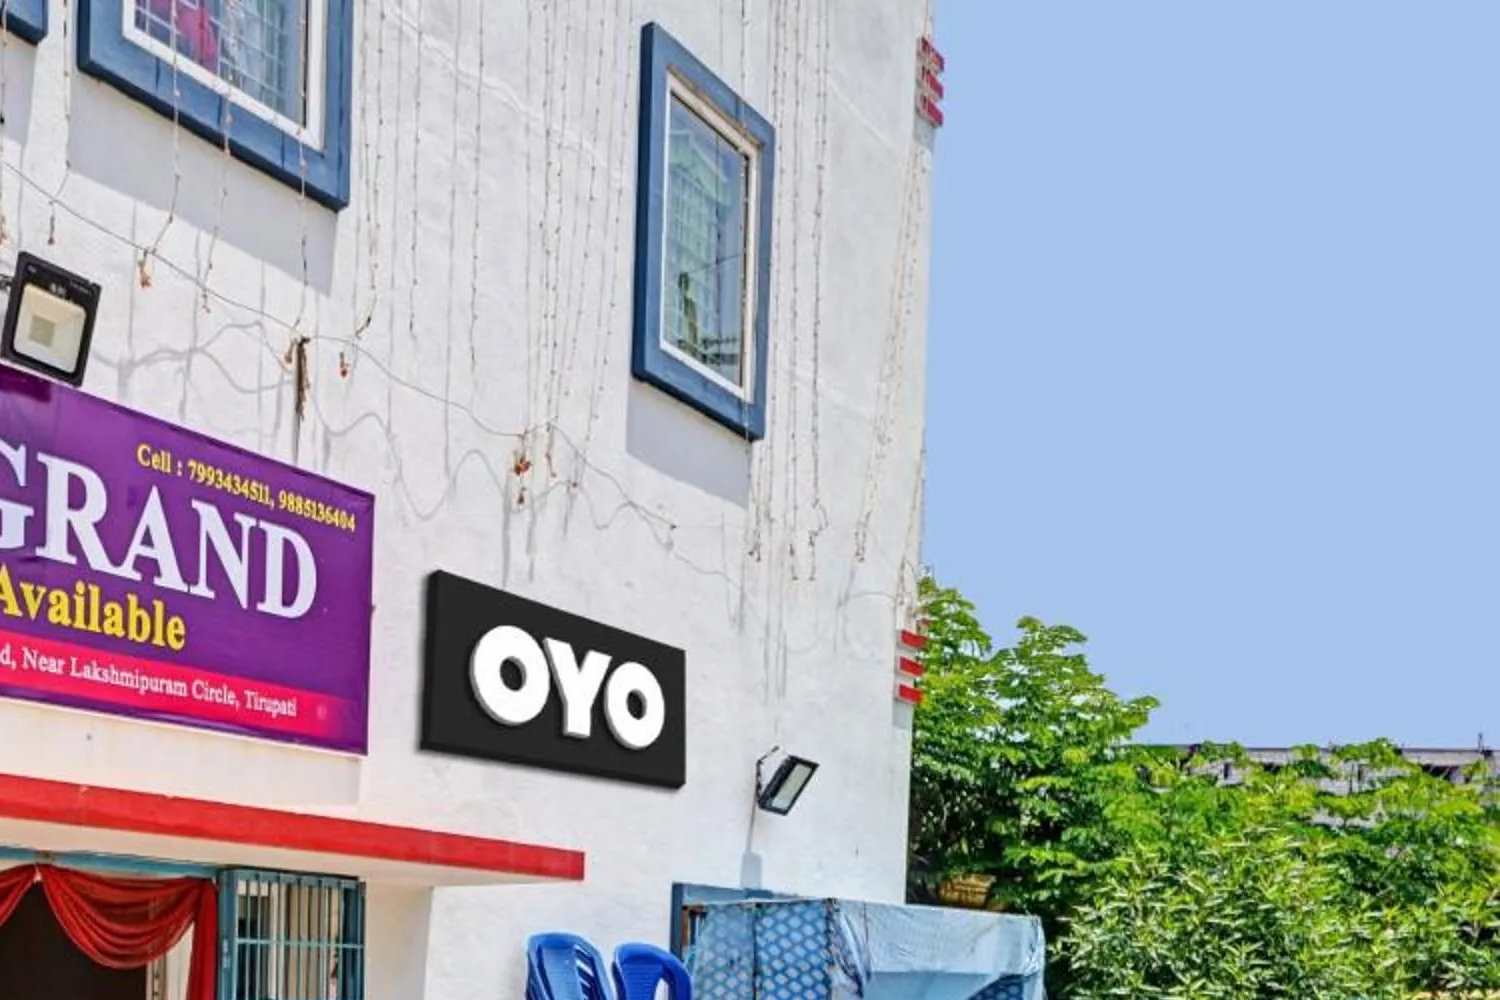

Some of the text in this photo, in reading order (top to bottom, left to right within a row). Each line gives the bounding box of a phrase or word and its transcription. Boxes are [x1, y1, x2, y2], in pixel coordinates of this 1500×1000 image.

[136, 443, 171, 474] Cell
[188, 459, 275, 510] 7993434511,
[278, 489, 357, 532] 9885136404
[22, 649, 66, 676] Near
[71, 657, 187, 696] Lakshmipuram
[192, 679, 240, 709] Circle,
[244, 690, 297, 718] Tirupati
[469, 624, 666, 751] OYO
